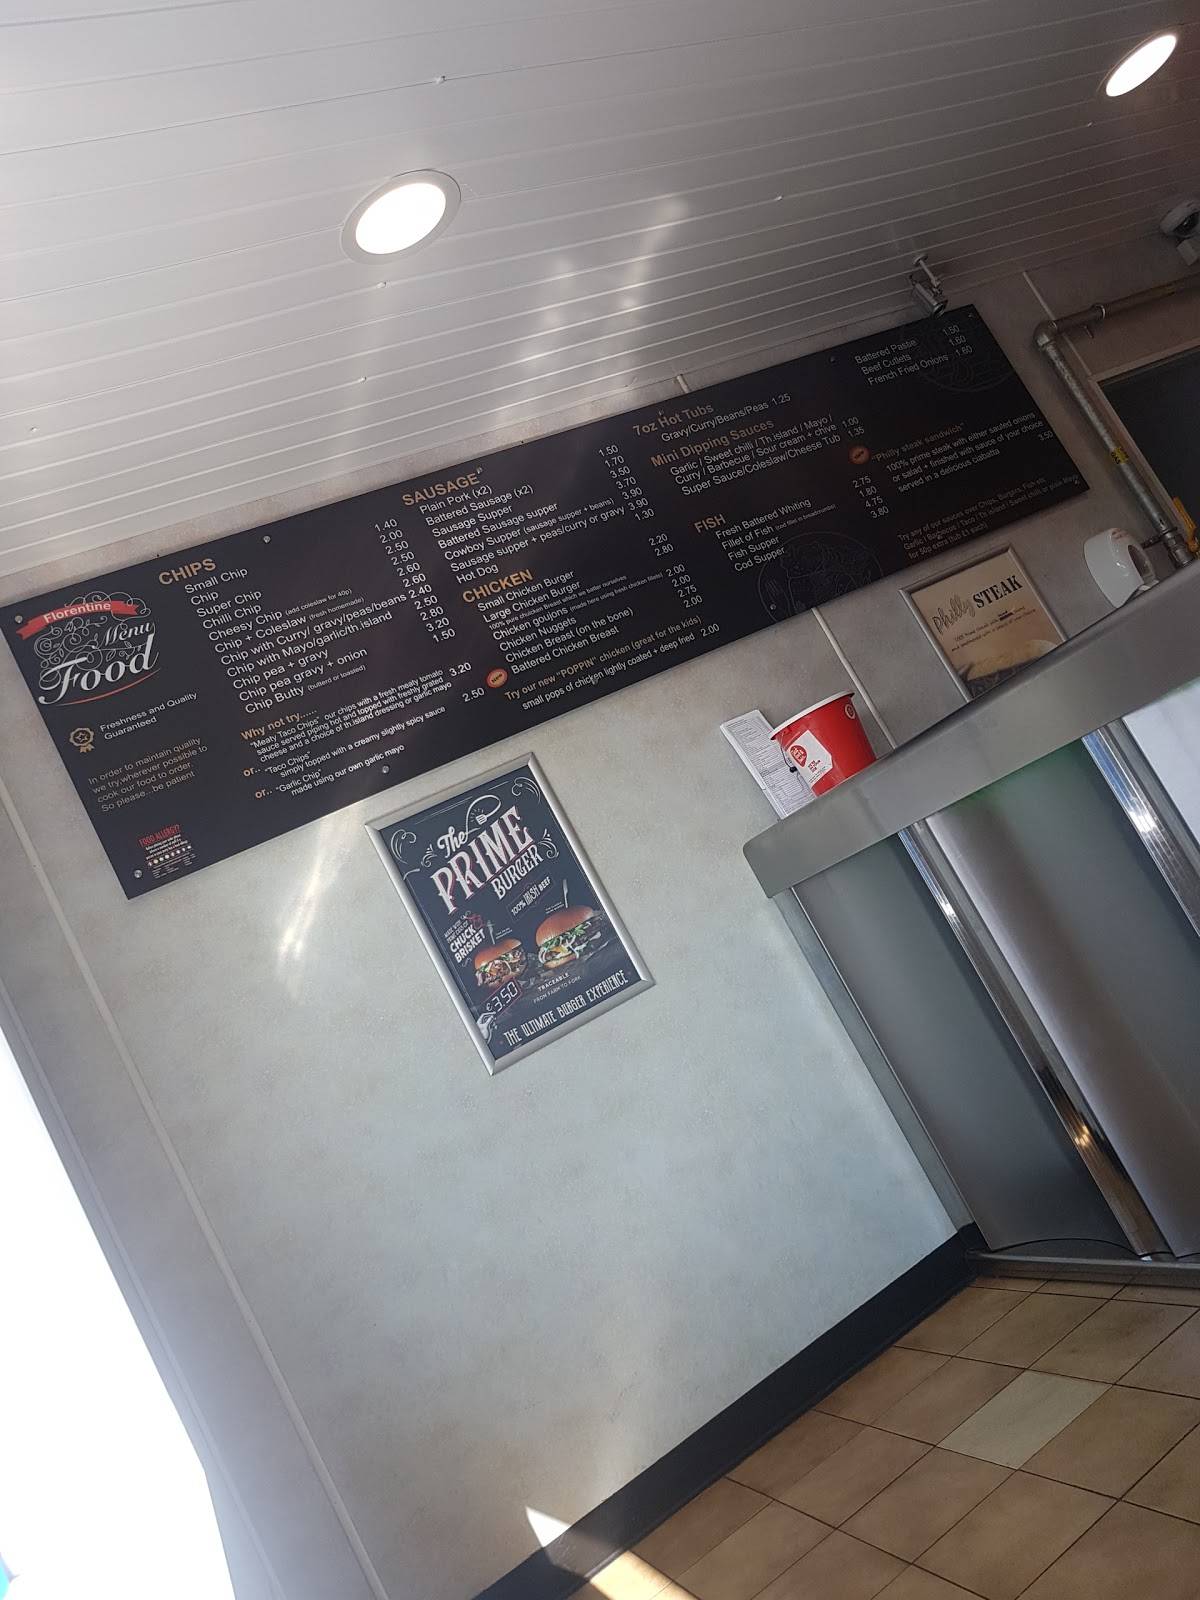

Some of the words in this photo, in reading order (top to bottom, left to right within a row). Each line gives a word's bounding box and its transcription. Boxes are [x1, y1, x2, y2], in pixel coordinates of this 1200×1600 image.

[631, 422, 658, 435] 7oz
[657, 415, 682, 427] Hot
[681, 404, 713, 419] Tubs
[650, 448, 679, 466] Mini
[679, 435, 730, 457] Dipping
[729, 420, 774, 440] Sauces
[660, 402, 769, 441] Gravy/Curry/Beans/Peas
[771, 392, 790, 405] 1.25
[401, 475, 480, 505] SAUSAGE
[418, 500, 446, 514] Plain
[445, 492, 471, 505] Pork
[471, 484, 492, 499] (x2)
[598, 444, 618, 456] 1.50
[424, 504, 469, 525] Battered
[468, 492, 512, 511] Sausage
[513, 484, 533, 498] (x2)
[604, 454, 624, 467] 1.70
[681, 479, 711, 495] Super
[712, 441, 822, 484] Sauce/Coleslaw/Cheese
[821, 434, 840, 444] Tub
[847, 426, 864, 437] 1.35
[431, 517, 476, 537] Sausage
[476, 505, 512, 522] Supper
[609, 465, 630, 478] 3.50
[437, 527, 481, 549] Battered
[481, 514, 524, 534] Sausage
[525, 502, 557, 519] supper
[615, 476, 636, 489] 3.70
[693, 513, 726, 533] FISH
[714, 524, 742, 539] Fresh
[740, 509, 778, 529] Battered
[777, 499, 811, 515] Whiting
[851, 475, 871, 488] 2.75
[727, 548, 748, 560] Fish
[747, 536, 779, 553] Supper
[865, 495, 883, 507] 4.75
[158, 558, 216, 584] CHIPS
[184, 575, 218, 593] Small
[219, 568, 247, 582] Chip
[374, 518, 397, 531] 1.40
[190, 591, 218, 605] Chip
[378, 529, 403, 543] 2.00
[455, 570, 476, 584] Hot
[475, 563, 499, 576] Dog
[634, 507, 654, 520] 1.30
[733, 557, 754, 571] Cod
[753, 546, 784, 564] Supper
[869, 505, 889, 518] 3.80
[195, 599, 231, 617] Super
[233, 590, 262, 604] Chip
[384, 540, 409, 554] 2.50
[202, 612, 232, 629] Chilli
[233, 604, 261, 618] Chip
[390, 550, 414, 565] 2.50
[208, 620, 252, 640] Cheesy
[254, 610, 282, 624] Chip
[396, 561, 420, 576] 2.60
[462, 568, 532, 602] CHICKEN
[476, 594, 505, 611] Small
[504, 582, 543, 600] Chicken
[542, 570, 573, 587] Burger
[648, 532, 668, 546] 2.20
[482, 607, 511, 623] Large
[511, 593, 549, 611] Chicken
[549, 581, 580, 597] Burger
[653, 543, 674, 556] 2.80
[972, 575, 1023, 608] STEAK
[43, 602, 111, 624] Florentine
[101, 622, 152, 647] Menu
[214, 638, 242, 653] Chip
[254, 615, 306, 638] Coleslaw
[402, 572, 426, 587] 2.60
[220, 650, 248, 665] Chip
[249, 640, 274, 654] with
[312, 593, 407, 634] gravy/peas/beans
[407, 583, 432, 598] 2.40
[226, 662, 254, 677] Chip
[255, 652, 280, 666] with
[281, 610, 392, 657] Mayo/garlic/th.island
[413, 594, 438, 610] 2.50
[498, 632, 538, 651] Chicken
[537, 616, 576, 636] Nuggets
[671, 574, 690, 587] 2.00
[504, 642, 544, 662] Chicken
[543, 629, 575, 647] Breast
[575, 624, 591, 636] (on
[590, 618, 606, 628] the
[606, 606, 633, 622] bone)
[676, 583, 697, 597] 2.75
[510, 651, 551, 674] Battered
[551, 638, 589, 657] Chicken
[588, 625, 619, 642] Breast
[682, 594, 702, 608] 2.00
[38, 634, 159, 704] Food
[244, 698, 273, 713] Chip
[273, 685, 304, 702] Butty
[432, 627, 455, 642] 1.50
[99, 711, 147, 732] Freshness
[148, 702, 165, 714] and
[166, 692, 196, 707] Quality
[103, 715, 157, 739] Guaranteed
[91, 784, 106, 793] we
[161, 749, 197, 768] possible
[97, 790, 118, 802] cook
[120, 783, 134, 793] our
[136, 774, 156, 787] food
[99, 767, 122, 780] order
[134, 748, 172, 767] maintain
[172, 737, 200, 752] quality
[430, 806, 534, 915] PRIME
[437, 826, 468, 858] The
[490, 844, 544, 900] BURGER
[511, 901, 526, 916] 100%
[523, 884, 540, 906] IRISH
[540, 876, 551, 891] BEEF
[450, 924, 476, 952] CHUCK
[454, 928, 485, 963] BRISKET
[503, 1028, 522, 1046] THE
[520, 1010, 557, 1037] ULTIMATE
[557, 995, 587, 1018] BURGER
[586, 970, 628, 1002] EXPERIENCE
[538, 972, 570, 992] TRACEABLE
